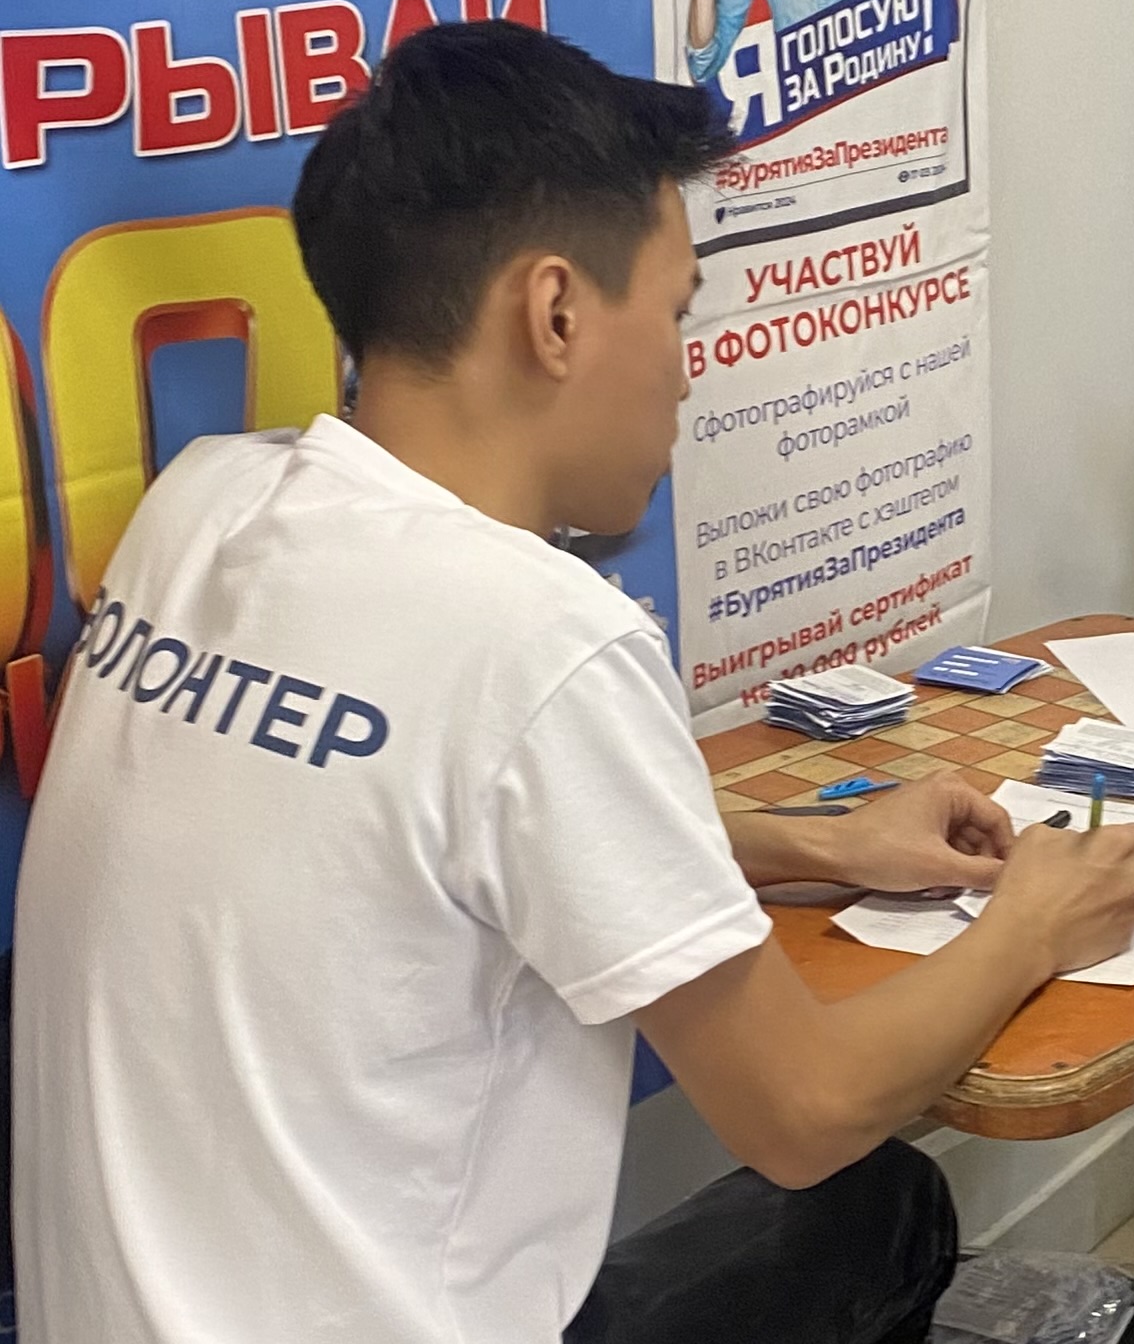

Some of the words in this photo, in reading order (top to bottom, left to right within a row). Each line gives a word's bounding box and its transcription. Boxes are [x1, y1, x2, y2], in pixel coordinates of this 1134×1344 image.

[717, 18, 783, 136] Я
[784, 67, 822, 112] ЗА
[714, 126, 949, 191] #БурятияЗаПрезидента
[744, 222, 922, 304] УЧАСТВУЙ
[687, 339, 707, 380] В
[713, 266, 971, 368] ФОТОКОНКУРСЕ
[692, 366, 894, 443] Сфотографируйся
[899, 361, 912, 380] с
[915, 335, 972, 376] нашей
[776, 394, 911, 462] фоторамкой
[696, 499, 789, 549] Выложи
[793, 479, 851, 513] свою
[855, 433, 973, 497] фотографию
[714, 560, 728, 581] в
[735, 517, 854, 574] ВКонтакте
[858, 511, 870, 530] с
[873, 474, 960, 525] хэштегом
[707, 506, 966, 623] #БурятияЗаПрезидента
[692, 608, 844, 690] Выигрывай
[850, 555, 973, 627] сертификат
[863, 603, 943, 665] рублей
